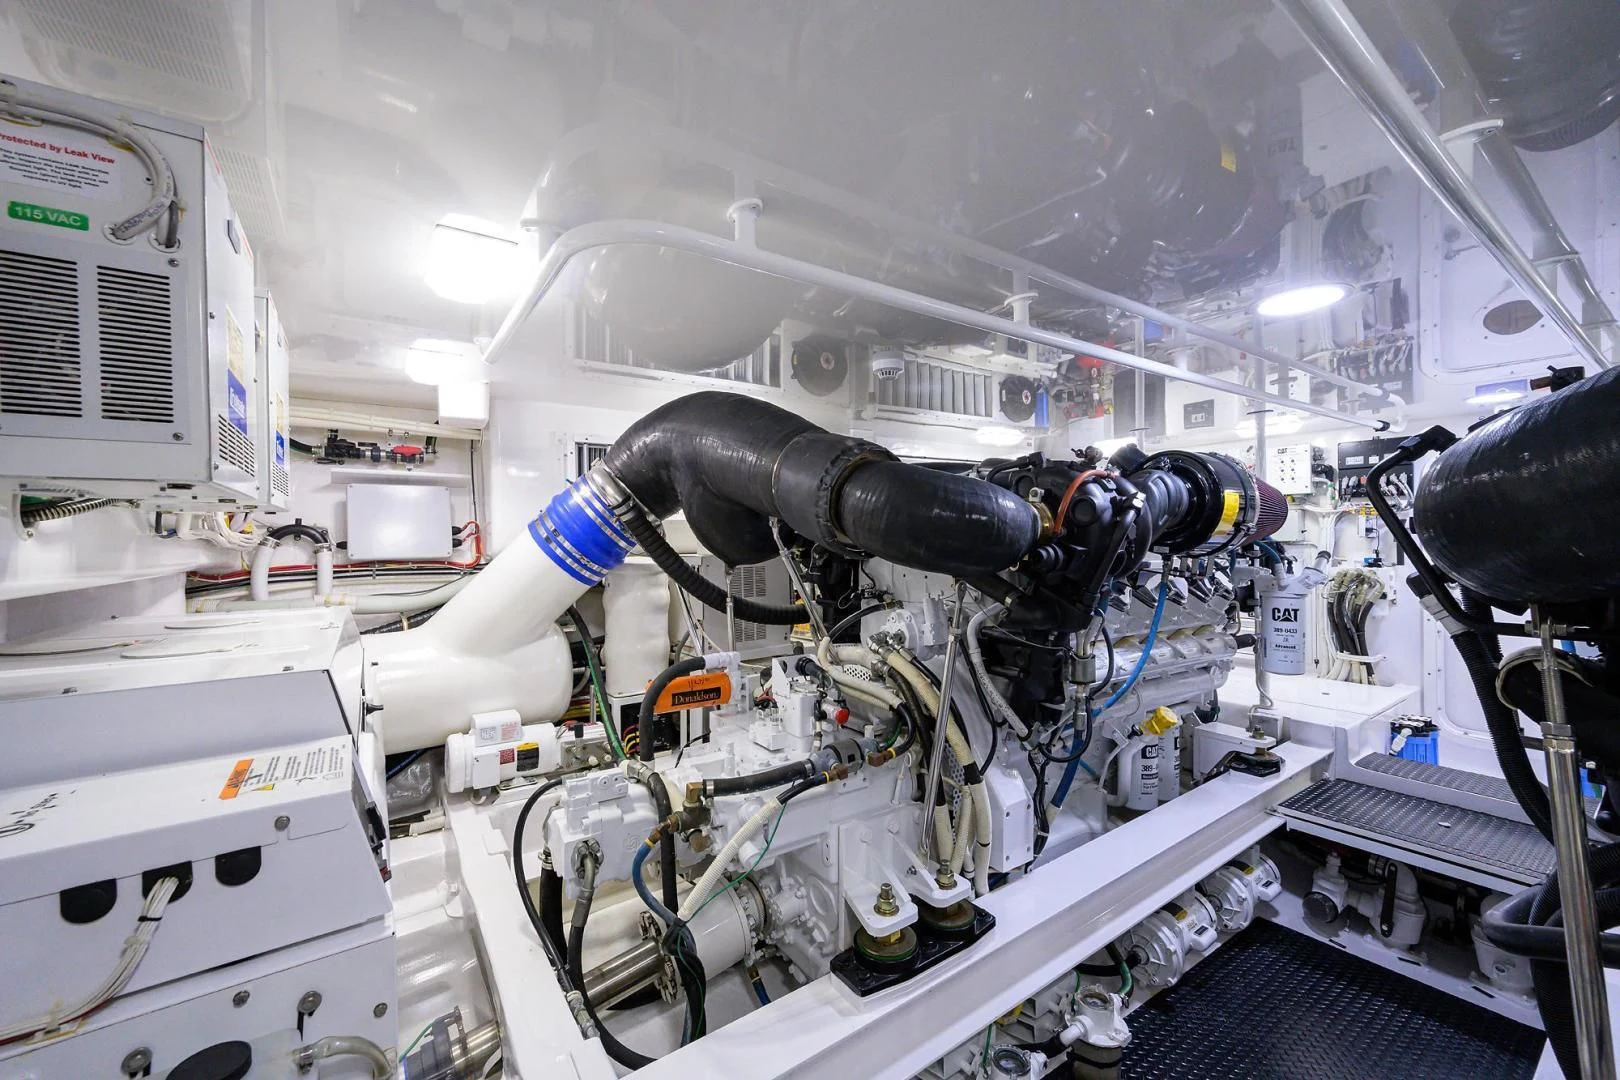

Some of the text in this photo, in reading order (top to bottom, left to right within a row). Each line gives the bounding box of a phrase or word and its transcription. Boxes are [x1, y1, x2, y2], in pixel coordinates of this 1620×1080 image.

[49, 143, 62, 153] by
[64, 147, 88, 159] Leak
[91, 153, 115, 164] View
[15, 206, 81, 226] 115 VAC
[1272, 607, 1299, 622] CAT
